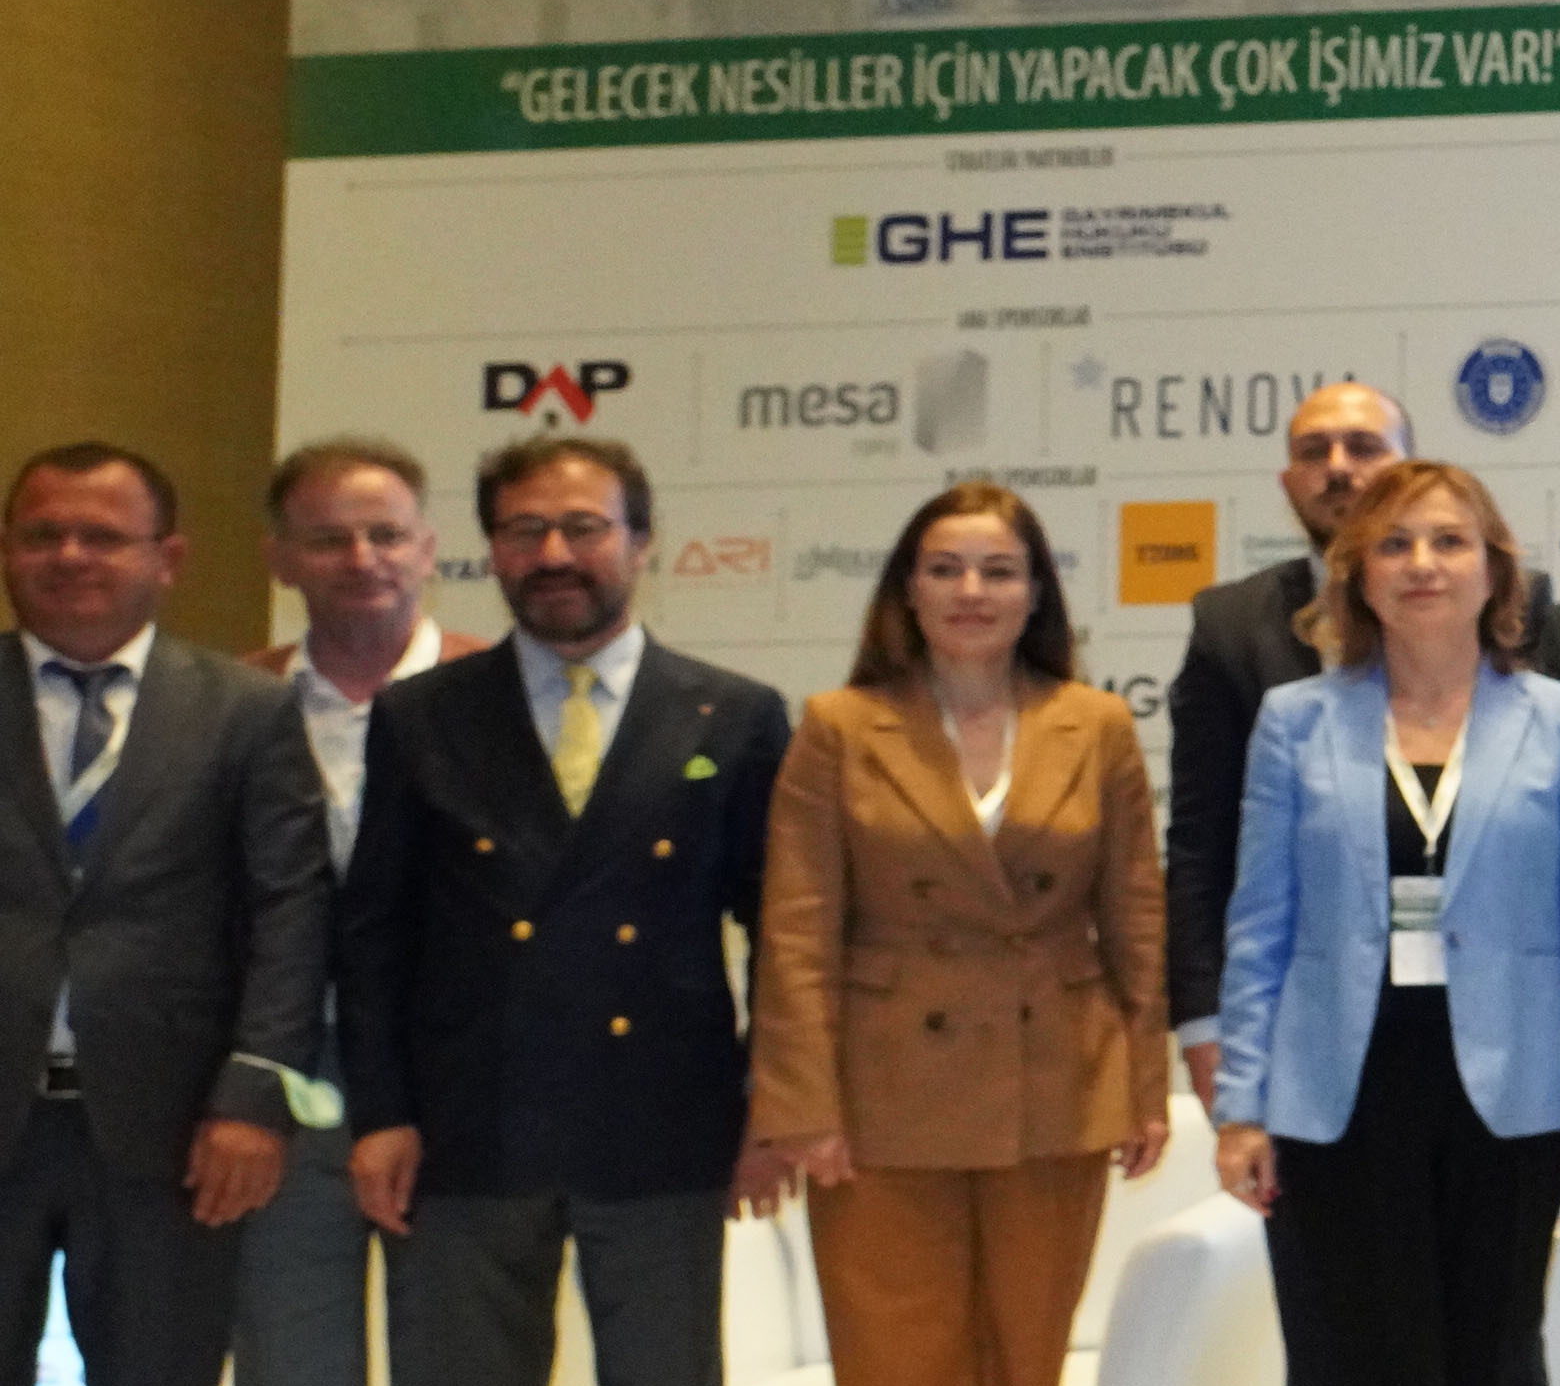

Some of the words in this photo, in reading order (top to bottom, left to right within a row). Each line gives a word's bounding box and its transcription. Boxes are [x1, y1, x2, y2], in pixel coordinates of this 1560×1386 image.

[709, 49, 902, 115] NESİLLER
[914, 41, 999, 120] İÇİN
[1008, 41, 1200, 103] YAPACAK
[1209, 37, 1298, 111] ÇOK
[1309, 24, 1444, 106] İŞİMİZ
[876, 210, 1050, 265] GHE
[739, 379, 898, 430] mesa
[1110, 370, 1357, 441] RENO
